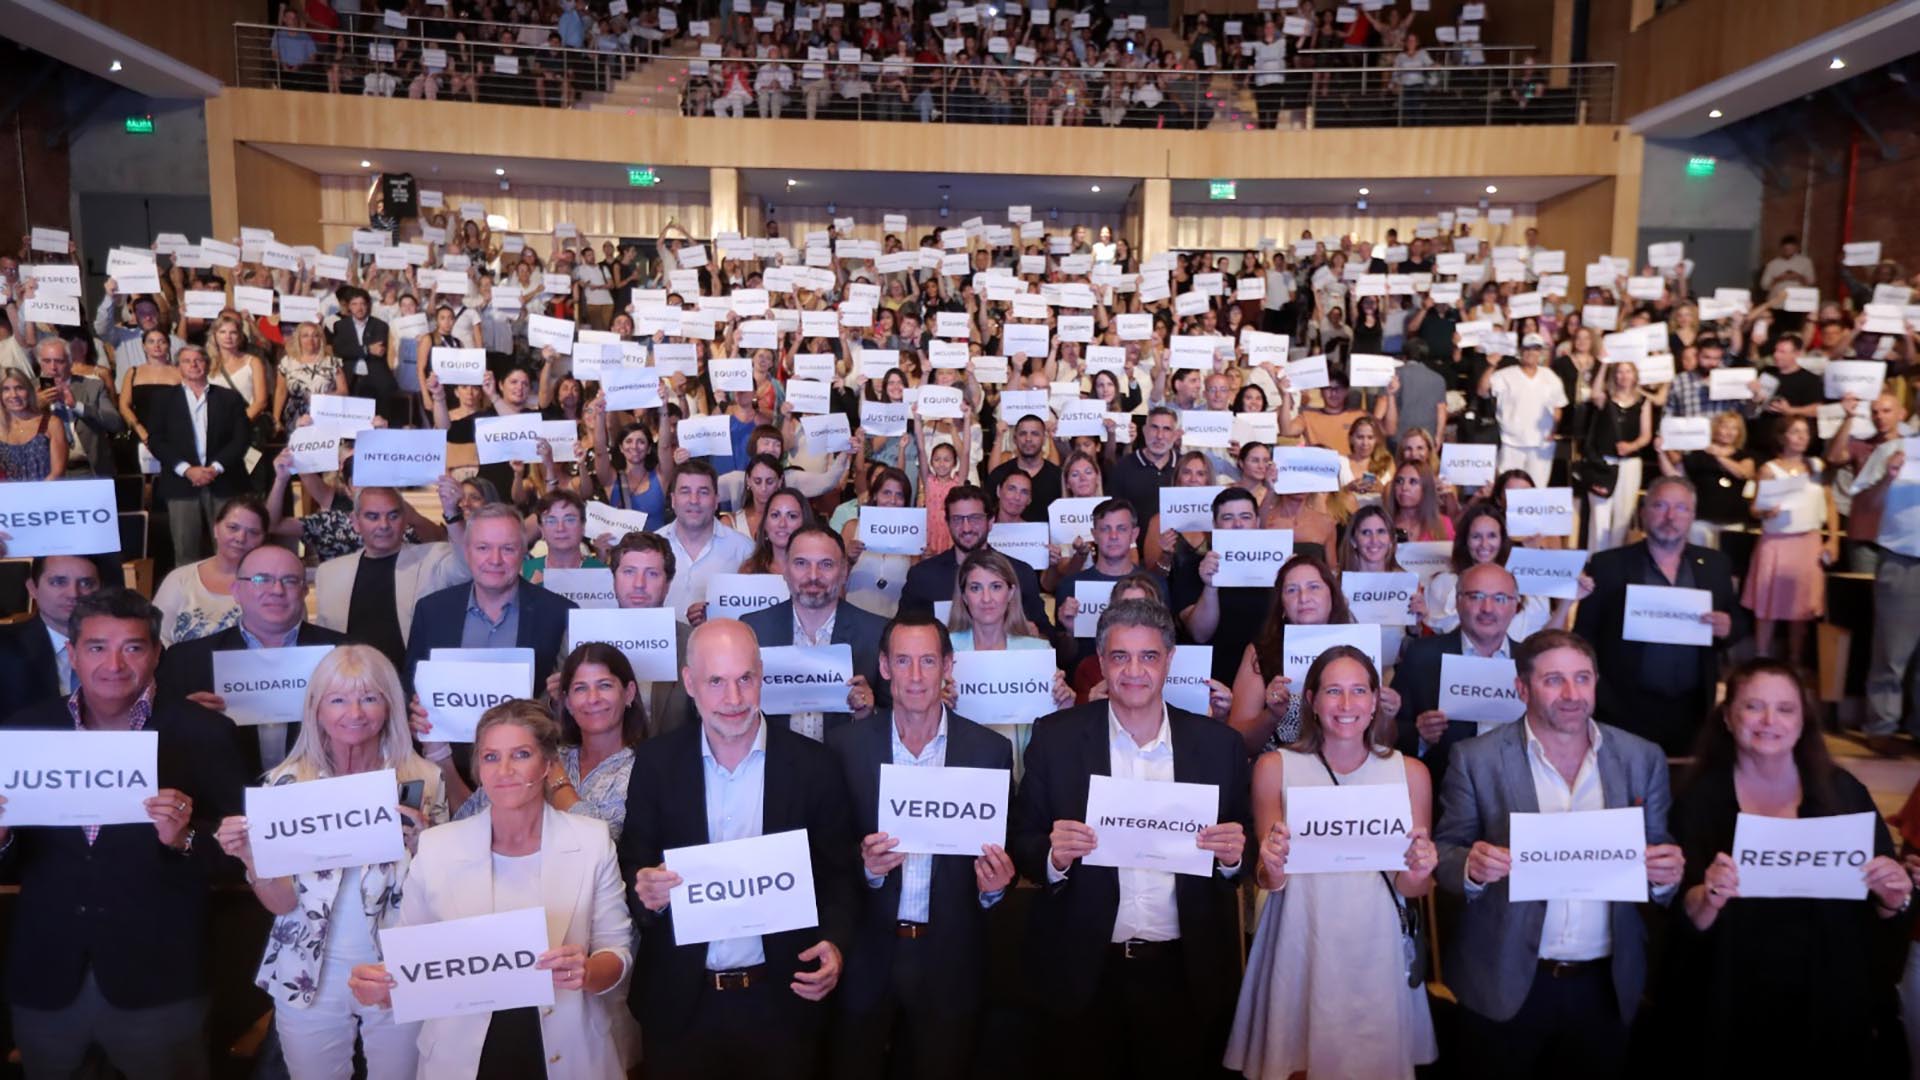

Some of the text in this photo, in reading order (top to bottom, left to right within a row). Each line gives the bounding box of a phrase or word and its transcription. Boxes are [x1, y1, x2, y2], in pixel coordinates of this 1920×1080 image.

[31, 302, 77, 312] JUSTICIA
[440, 360, 481, 370] EQUIPO
[714, 370, 748, 379] EQUIPO
[608, 382, 658, 393] COMPROMISO
[923, 396, 959, 405] EQUIPO
[866, 413, 906, 423] JUSTICIA
[1061, 411, 1103, 422] JUSTICIA
[683, 431, 728, 441] SOLIDARIDAD
[1185, 425, 1229, 434] INCLUSIÓN
[484, 430, 538, 443] VERDAD
[290, 439, 336, 453] VERDAD
[364, 451, 442, 464] INTEGRACIÓN
[1447, 458, 1493, 469] JUSTICIA
[1280, 464, 1336, 474] INTEGRACIÓN
[1167, 502, 1214, 514] JUSTIC
[1517, 505, 1567, 516] EQUIPO
[588, 511, 641, 532] HONESTIDAD
[1059, 512, 1095, 524] EQUIP
[870, 523, 920, 536] EQUIPO
[1224, 550, 1284, 562] EQUIPO
[1510, 566, 1573, 578] CERCANÍA
[719, 594, 780, 608] EQUIPO
[1352, 590, 1409, 602] EQUIPO
[1631, 609, 1701, 623] INTEGRACIÓ
[762, 670, 845, 685] CERCANÍA
[222, 678, 308, 694] SOLIDARID
[959, 678, 1050, 695] INCLUSIÓN
[1448, 683, 1517, 700] CERCAN
[4, 769, 149, 790] JUSTICIA
[891, 798, 998, 822] VERDAD
[264, 805, 393, 841] JUSTICIA
[1300, 817, 1406, 837] JUSTICIA
[1519, 848, 1637, 864] SOLIDARIDAD
[1740, 849, 1867, 868] RESPETO
[688, 871, 796, 905] EQUIPO
[400, 949, 537, 984] VERDAD
